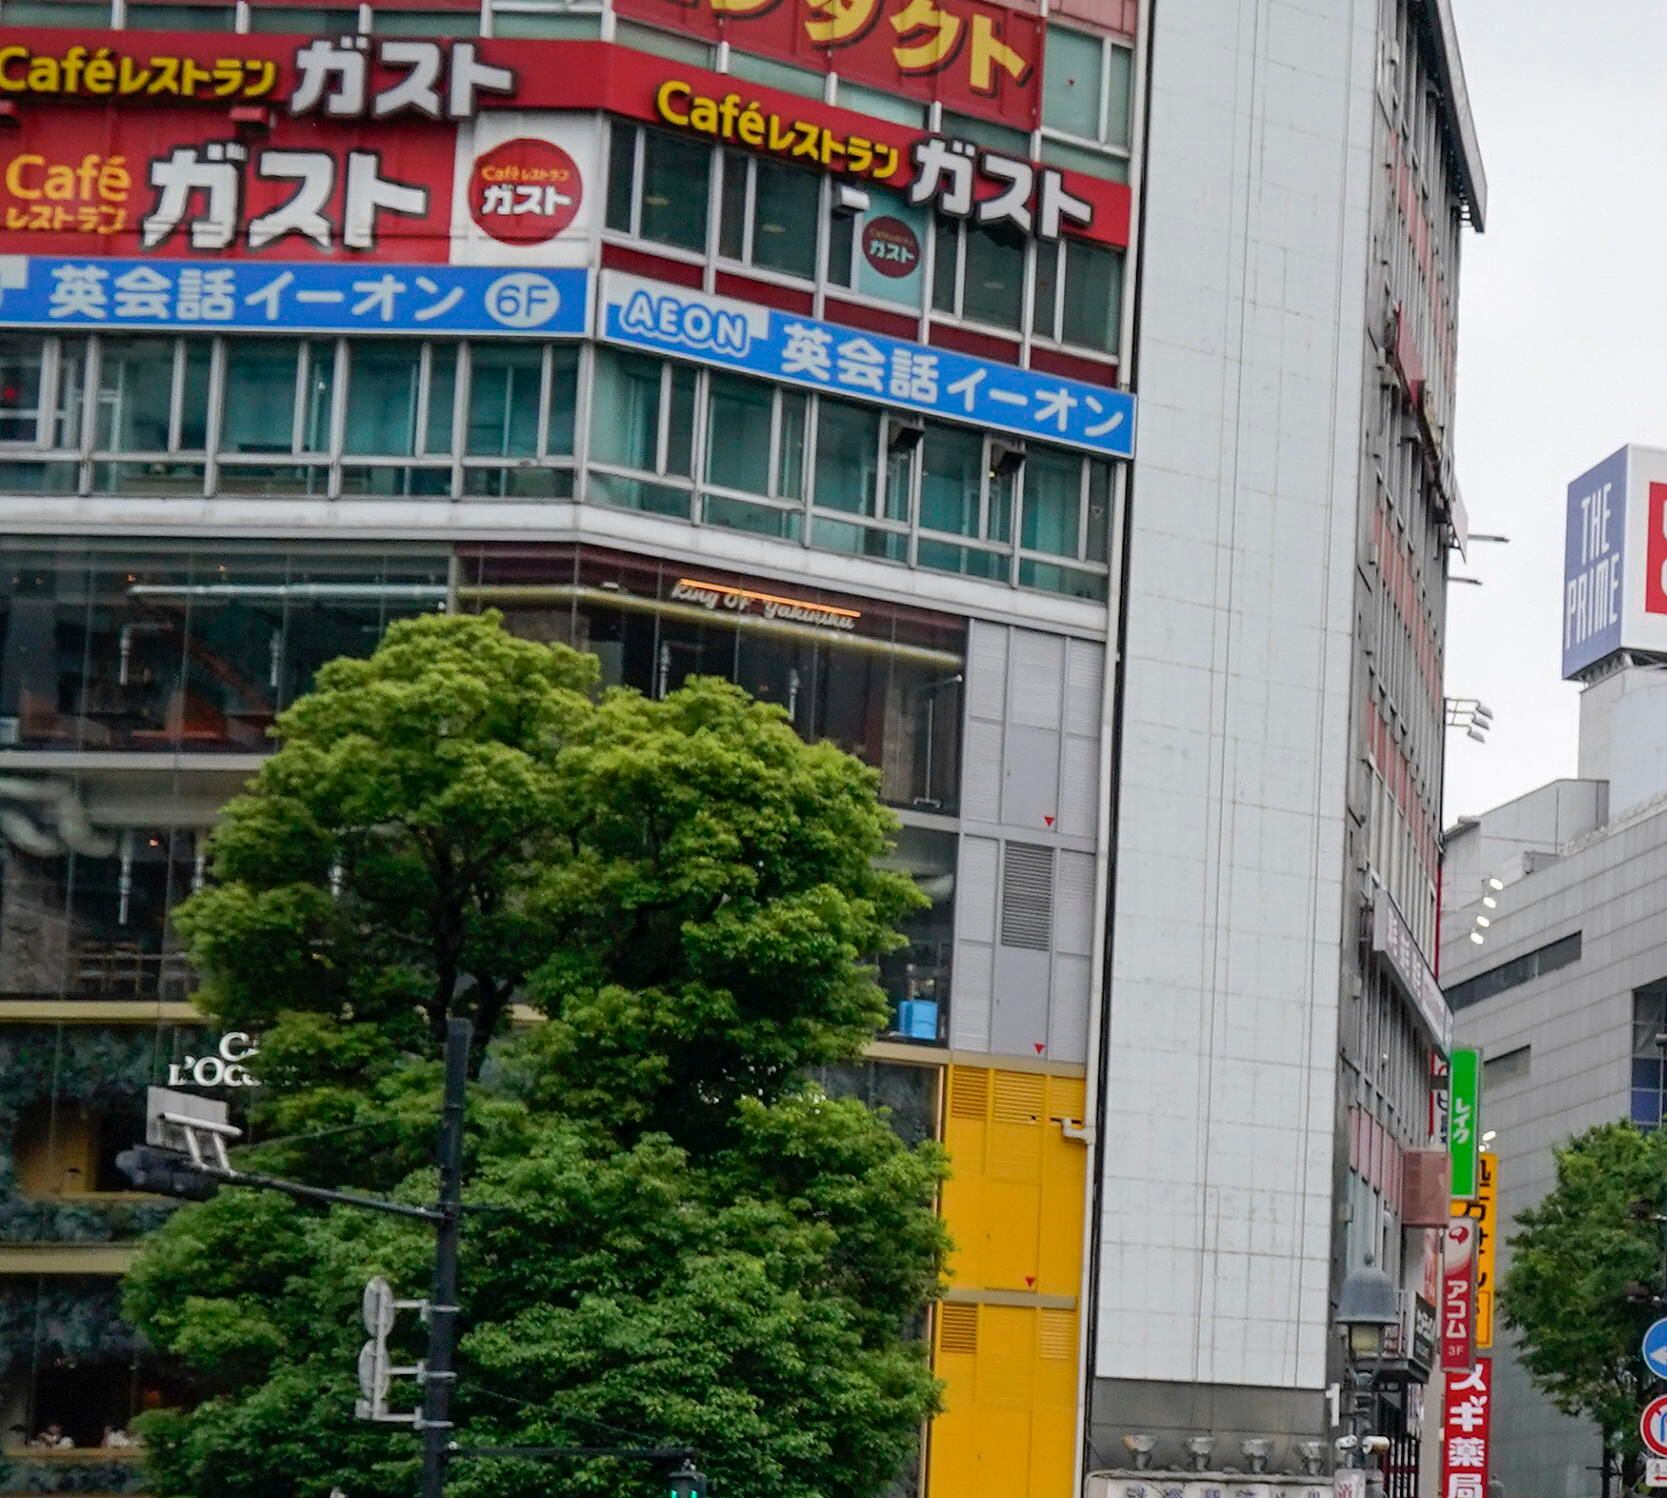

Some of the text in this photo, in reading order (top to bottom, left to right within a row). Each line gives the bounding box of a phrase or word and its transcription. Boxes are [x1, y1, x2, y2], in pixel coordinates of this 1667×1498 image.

[290, 35, 514, 118] ガスト
[5, 154, 131, 201] Café
[142, 143, 427, 249] ガスト
[480, 184, 574, 217] ガスト
[911, 138, 1092, 240] ガスト
[6, 206, 127, 234] レストラン
[49, 264, 464, 321] 英会話イーオン
[622, 293, 752, 355] AEON
[780, 322, 1126, 437] 英会話イーオン
[1581, 482, 1612, 565] THE
[1565, 553, 1620, 650] PRIME
[1452, 1098, 1472, 1145] レイク
[1446, 1280, 1469, 1339] アコム
